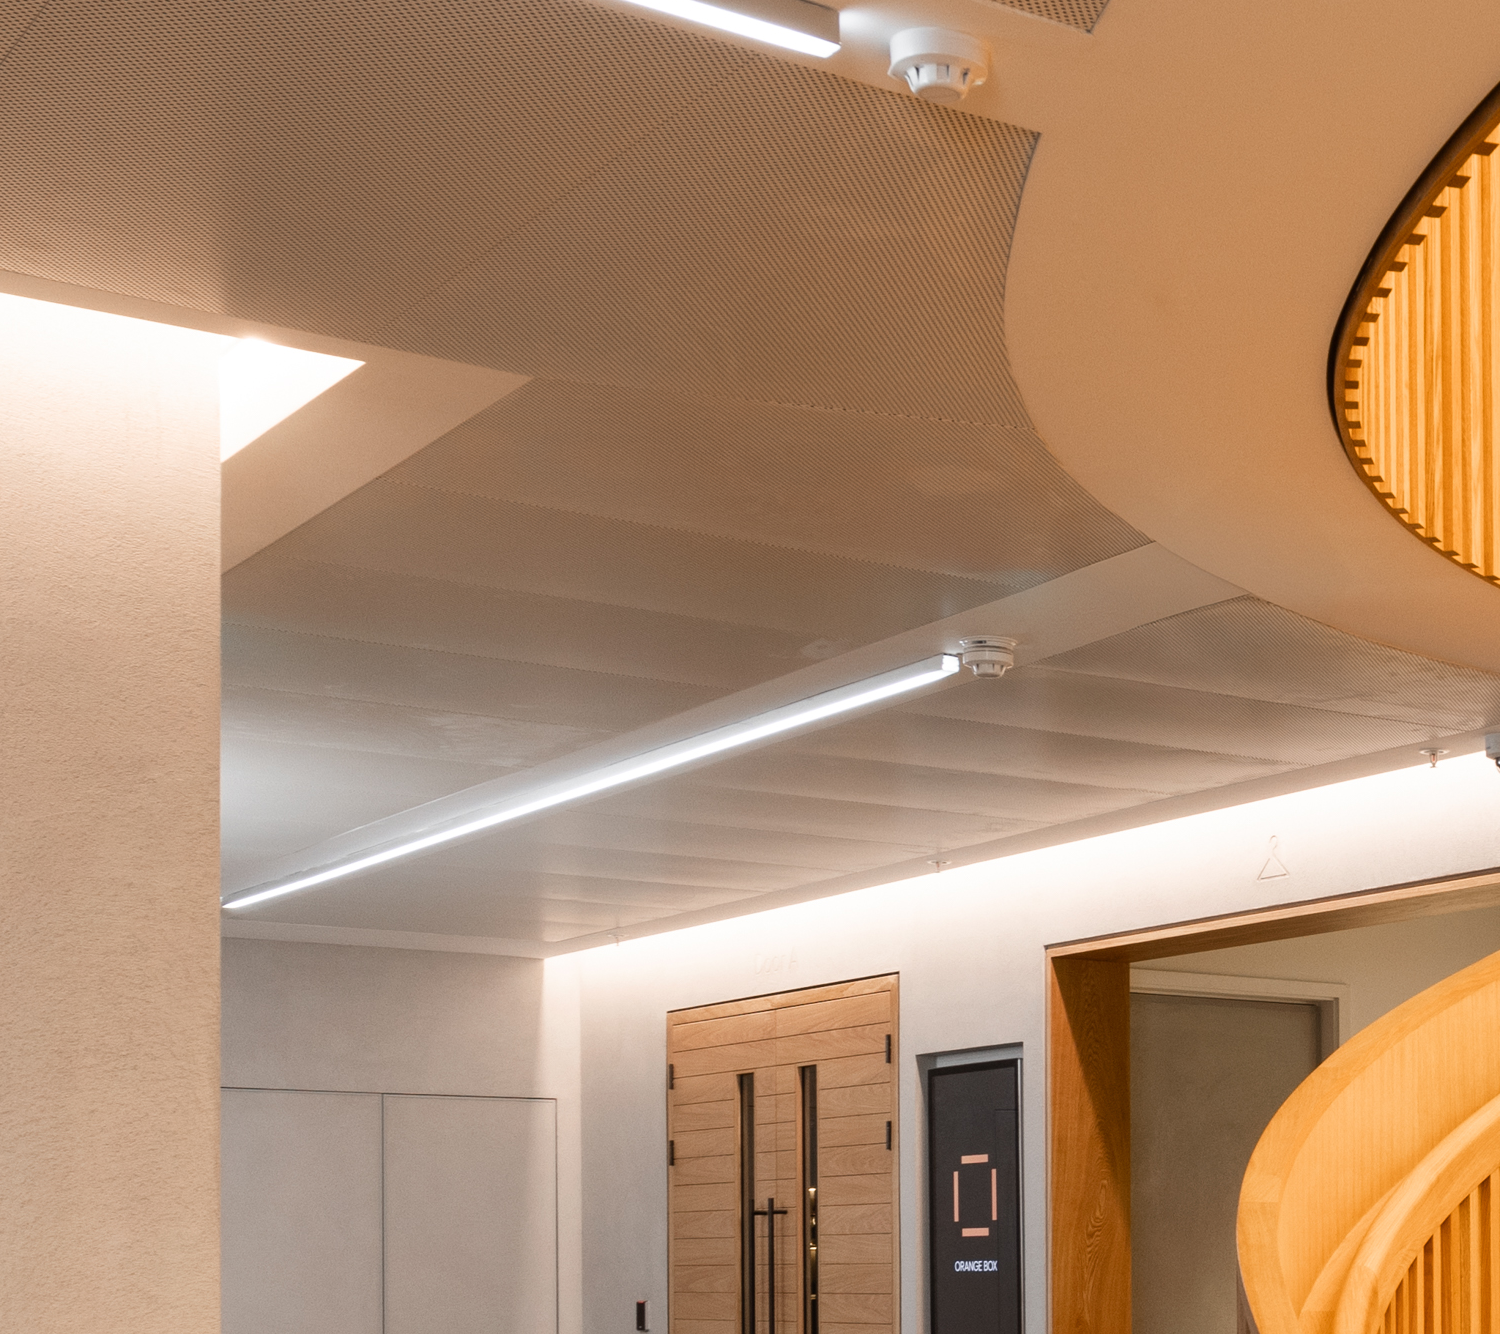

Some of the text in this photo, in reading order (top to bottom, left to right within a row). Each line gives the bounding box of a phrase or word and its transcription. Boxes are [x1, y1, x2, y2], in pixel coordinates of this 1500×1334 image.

[788, 946, 799, 970] A
[954, 1260, 998, 1272] ORANGE BOX
